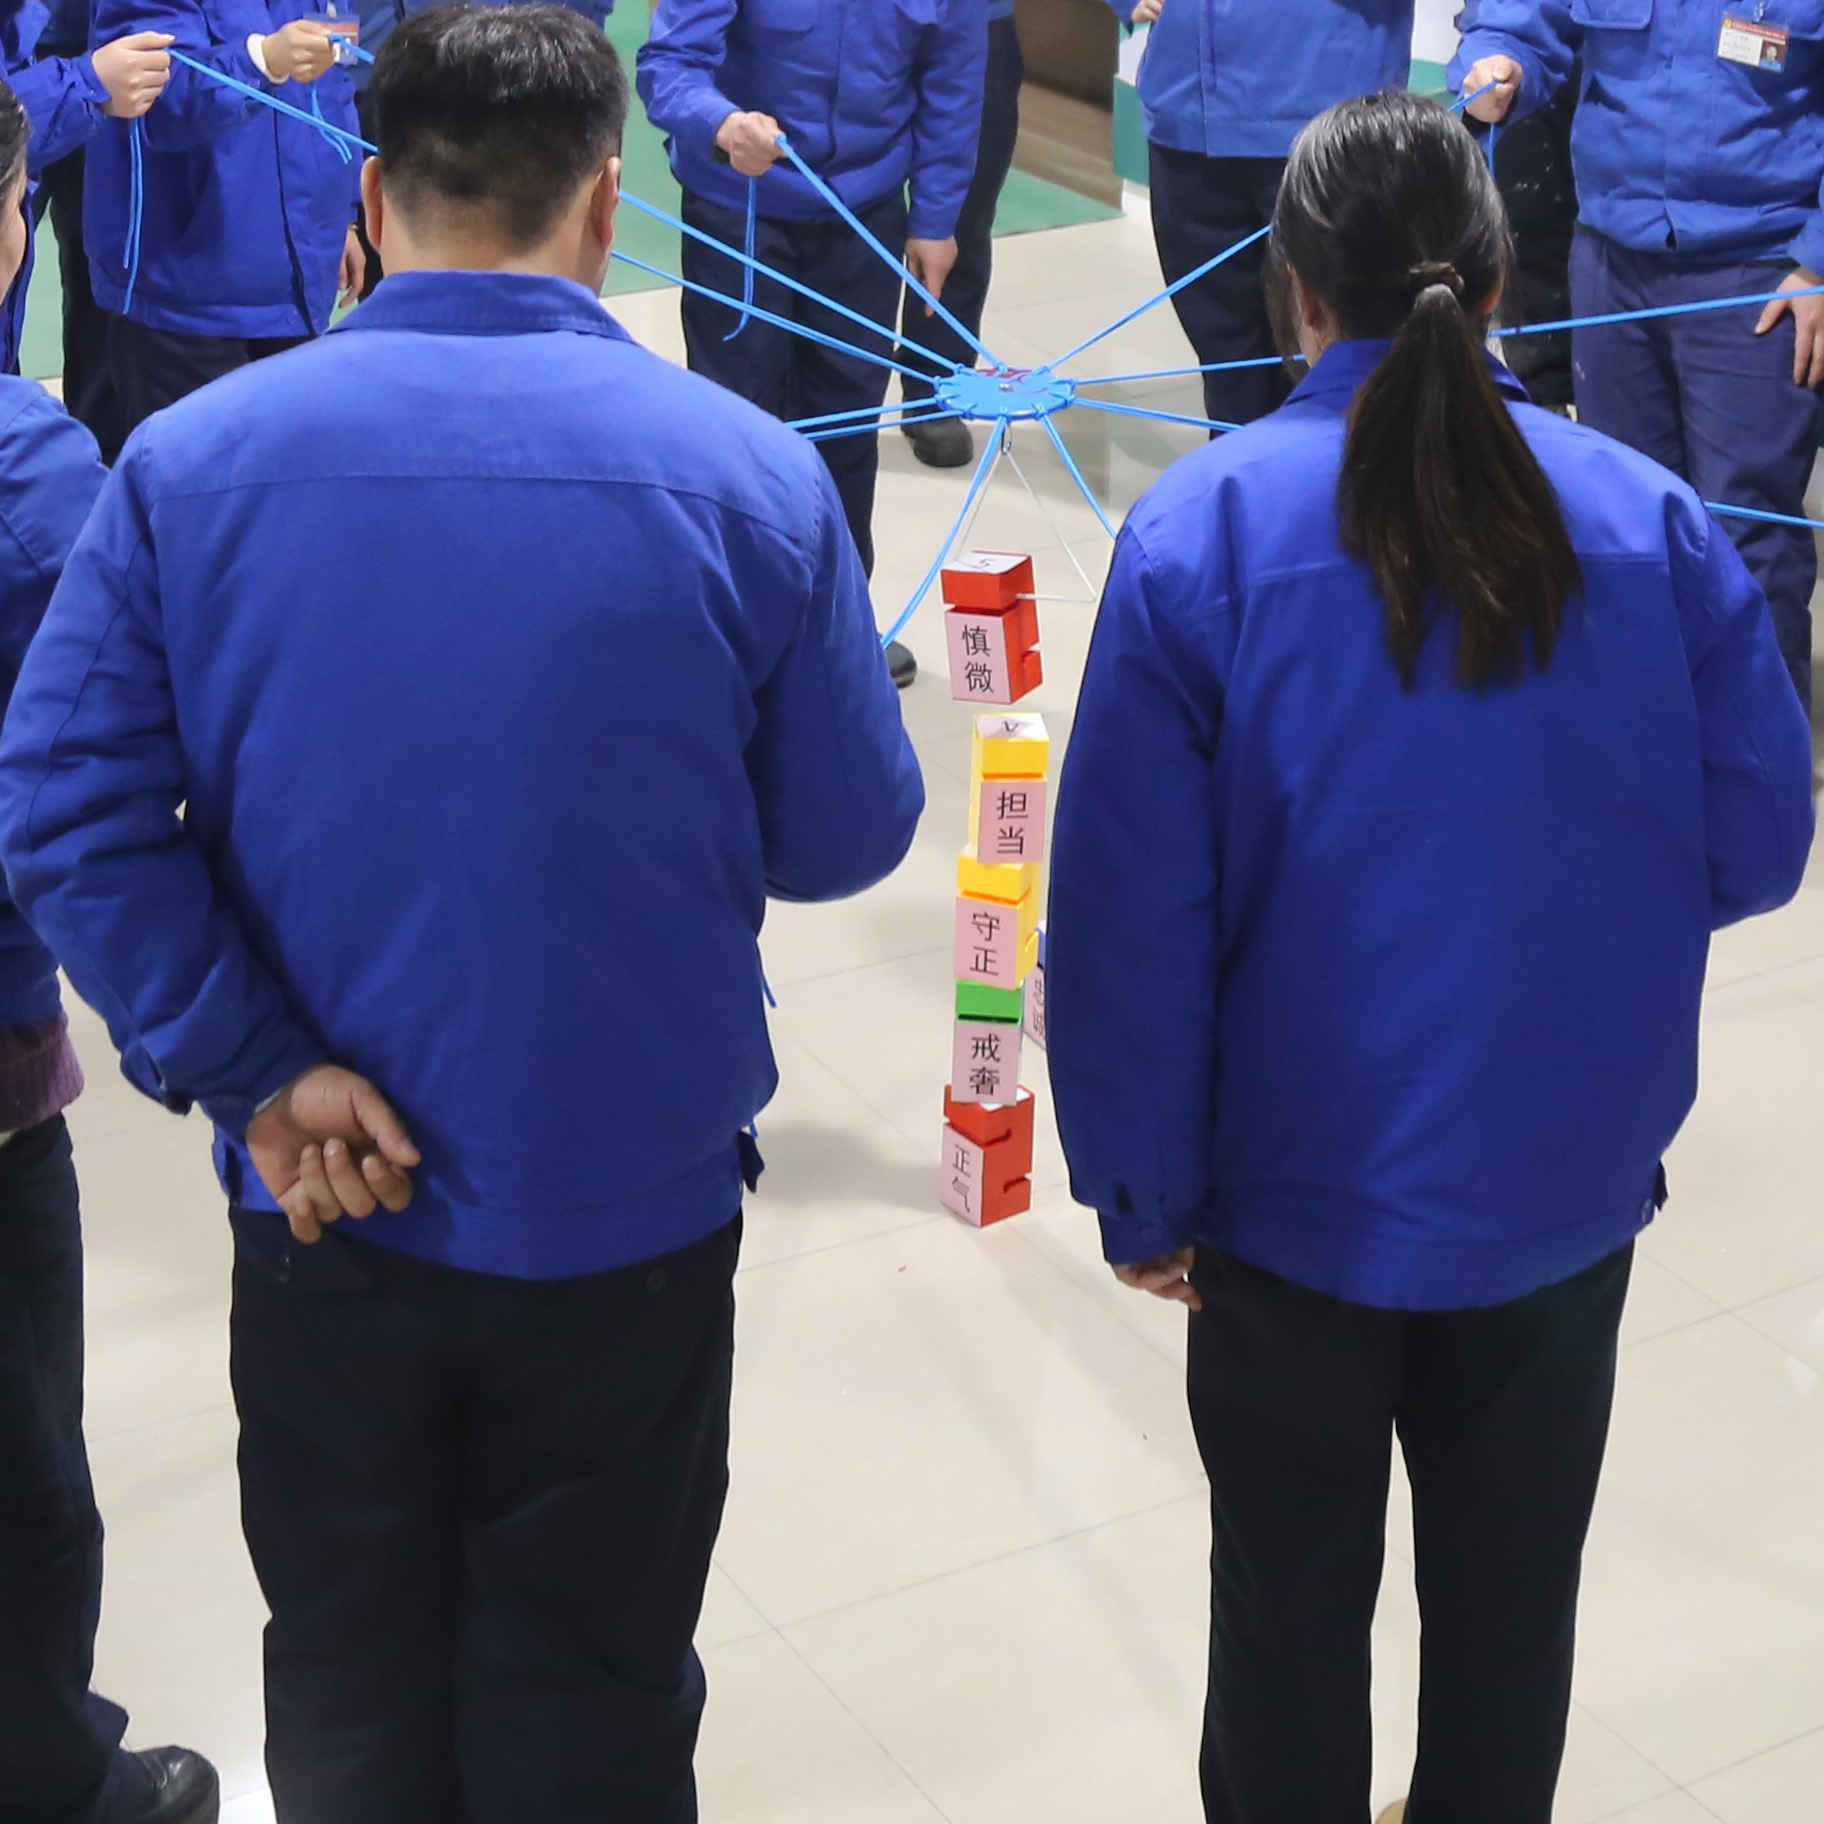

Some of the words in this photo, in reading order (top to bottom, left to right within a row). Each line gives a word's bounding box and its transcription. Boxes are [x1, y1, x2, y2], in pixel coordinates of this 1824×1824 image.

[962, 624, 994, 694] 慎微
[996, 790, 1028, 856] 担当
[969, 911, 1001, 977] 守正
[969, 1033, 1002, 1096] 戒奢
[951, 1143, 972, 1213] 正气
